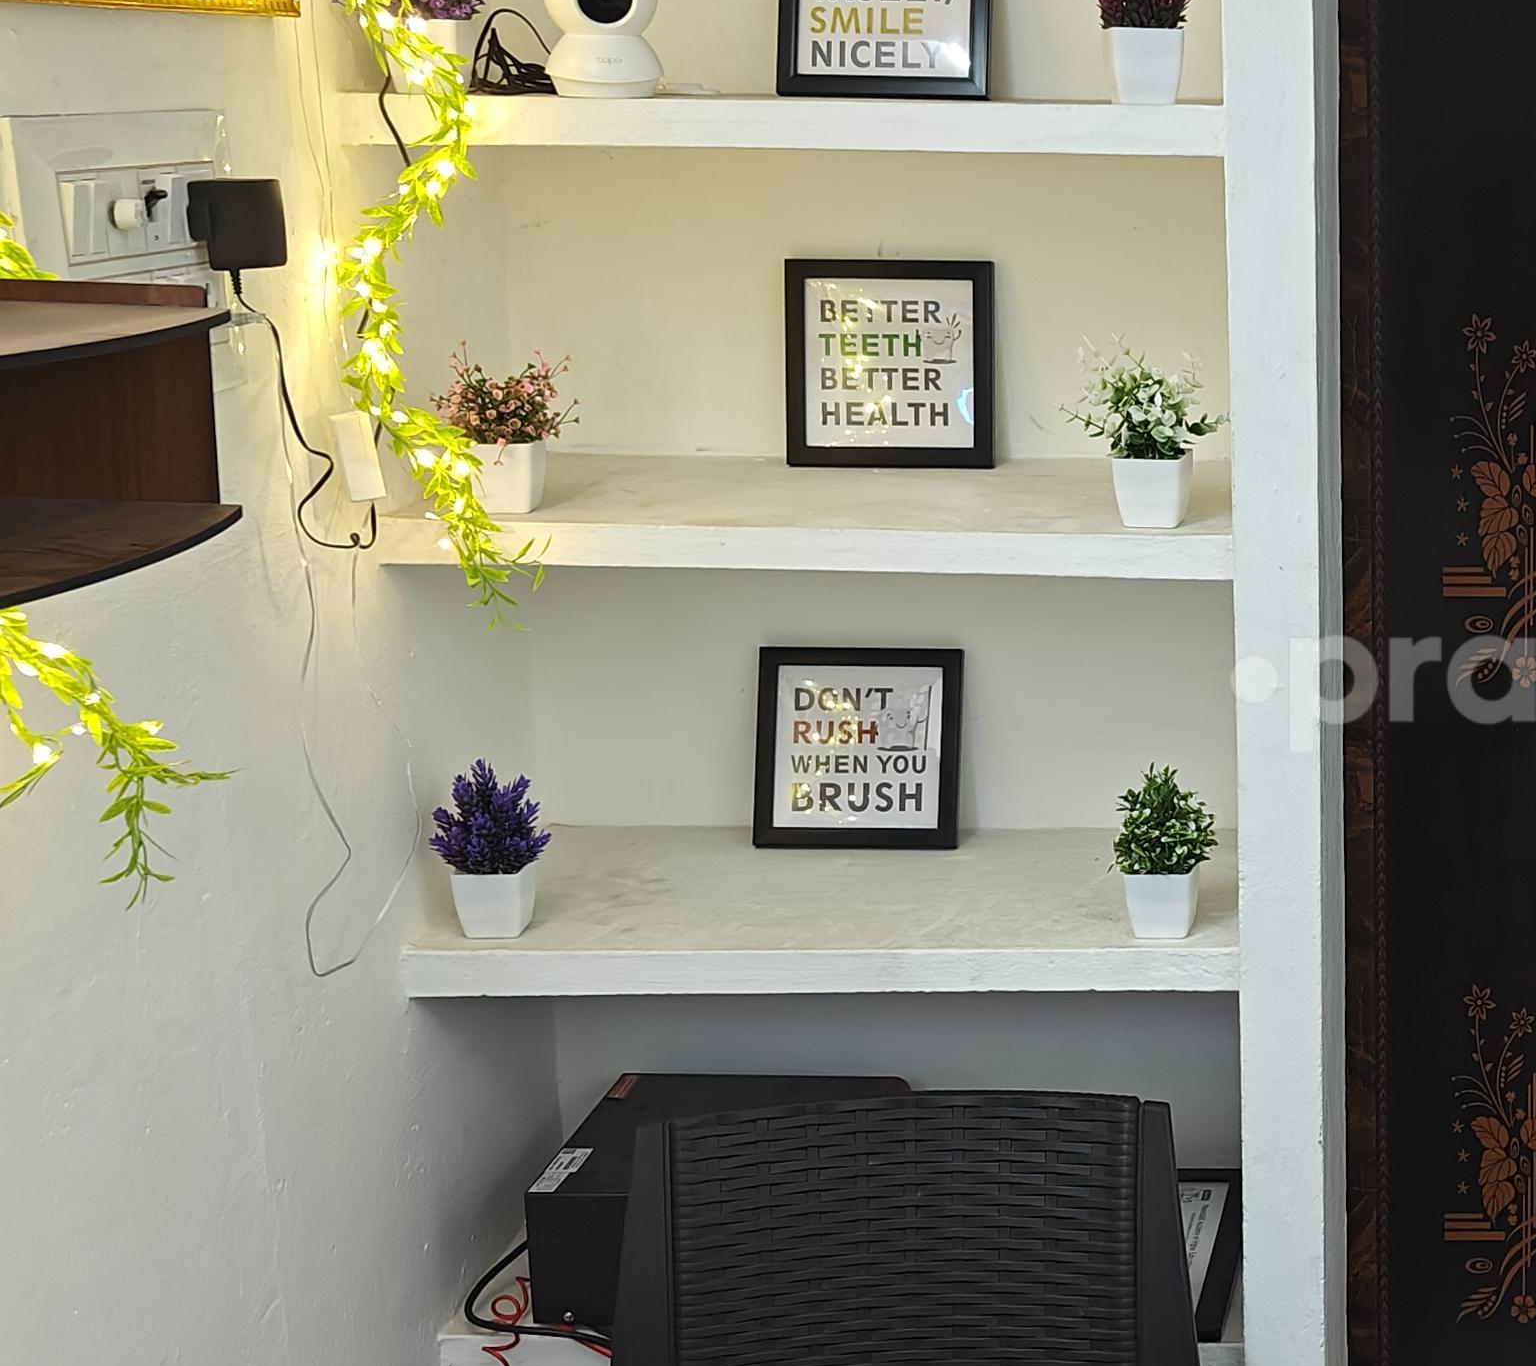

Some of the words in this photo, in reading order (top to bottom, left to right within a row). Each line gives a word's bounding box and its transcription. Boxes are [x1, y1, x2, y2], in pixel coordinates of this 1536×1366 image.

[809, 6, 924, 35] SMILE
[811, 40, 942, 69] NICELY
[820, 299, 942, 324] BETTER
[818, 333, 922, 357] TEETH
[820, 367, 942, 391] BETTER
[821, 401, 949, 427] HEALTH
[794, 687, 894, 712] DON'T
[793, 720, 879, 745] RUSH
[791, 754, 868, 774] WHEN
[876, 754, 926, 774] YOU
[791, 782, 923, 813] BRUSH
